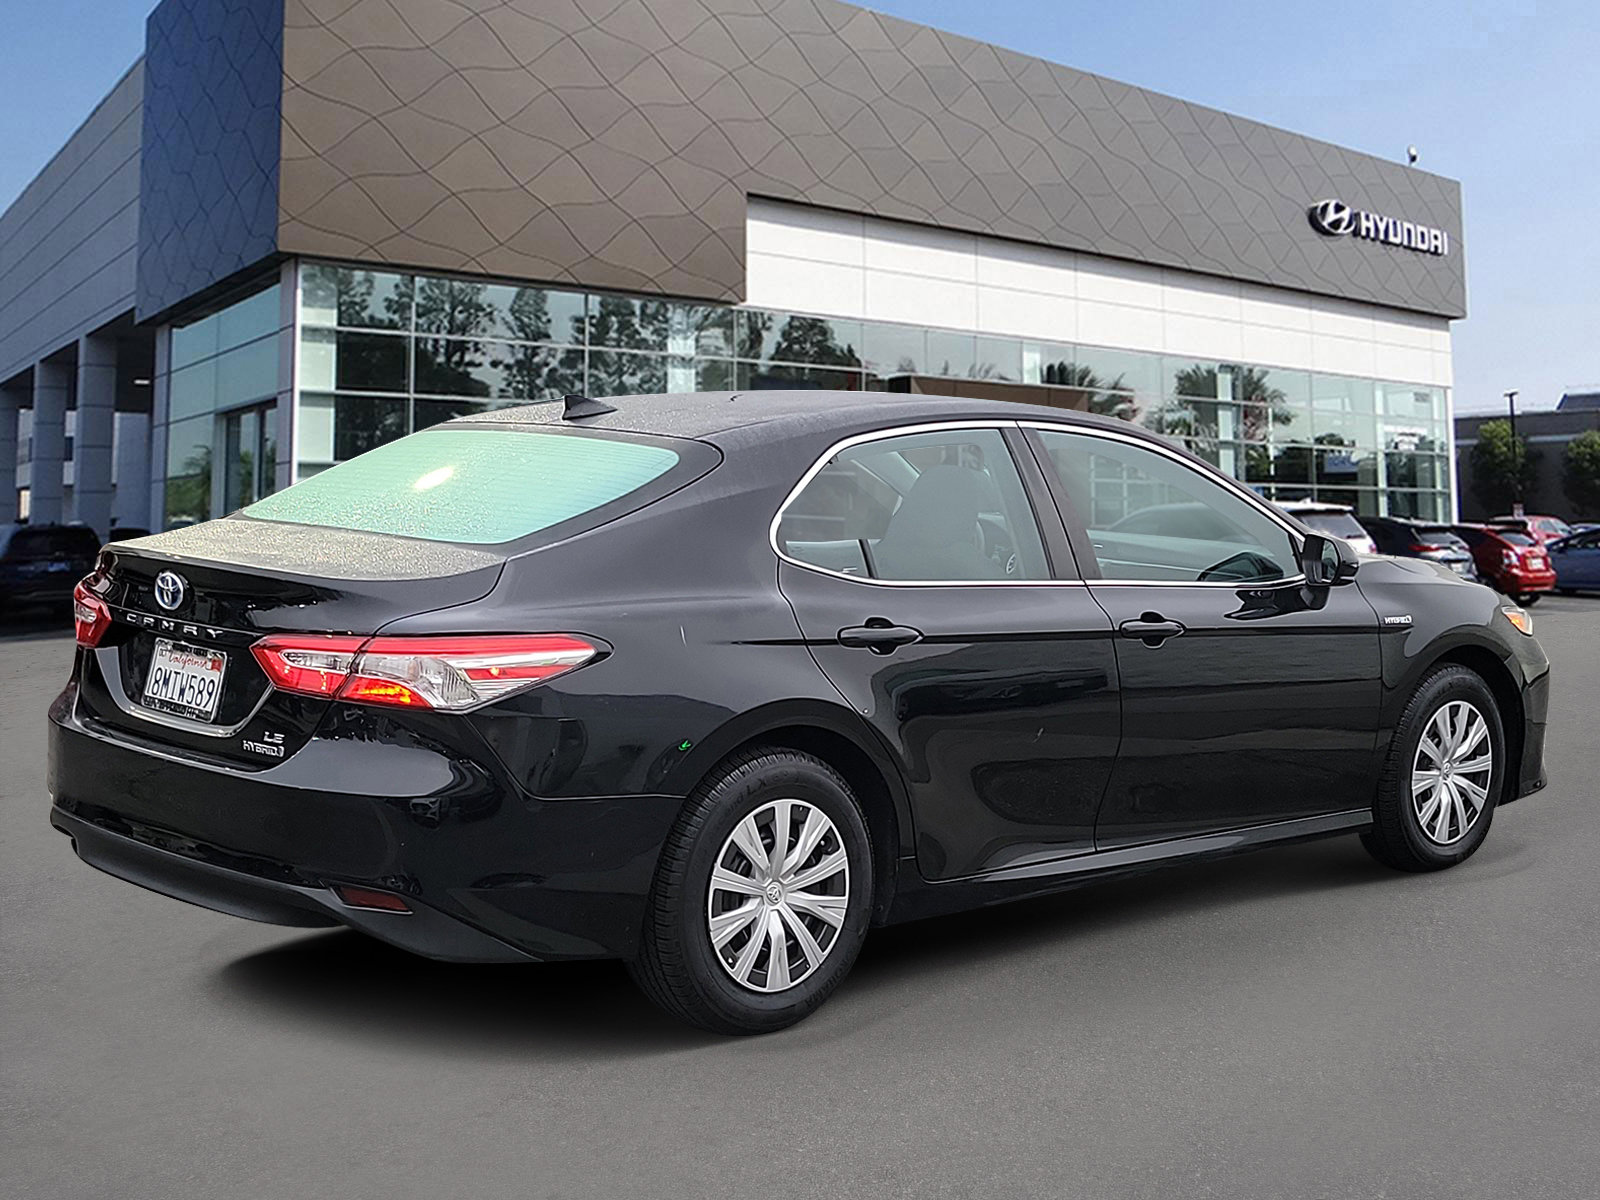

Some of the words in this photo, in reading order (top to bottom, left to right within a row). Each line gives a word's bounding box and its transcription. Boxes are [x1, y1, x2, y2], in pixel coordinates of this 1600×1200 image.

[1360, 211, 1448, 255] HYUNDAI
[126, 613, 224, 638] CAMRY
[168, 650, 207, 670] California
[151, 667, 215, 709] 8MIW589
[243, 740, 284, 757] HYBRID
[263, 731, 285, 744] LE
